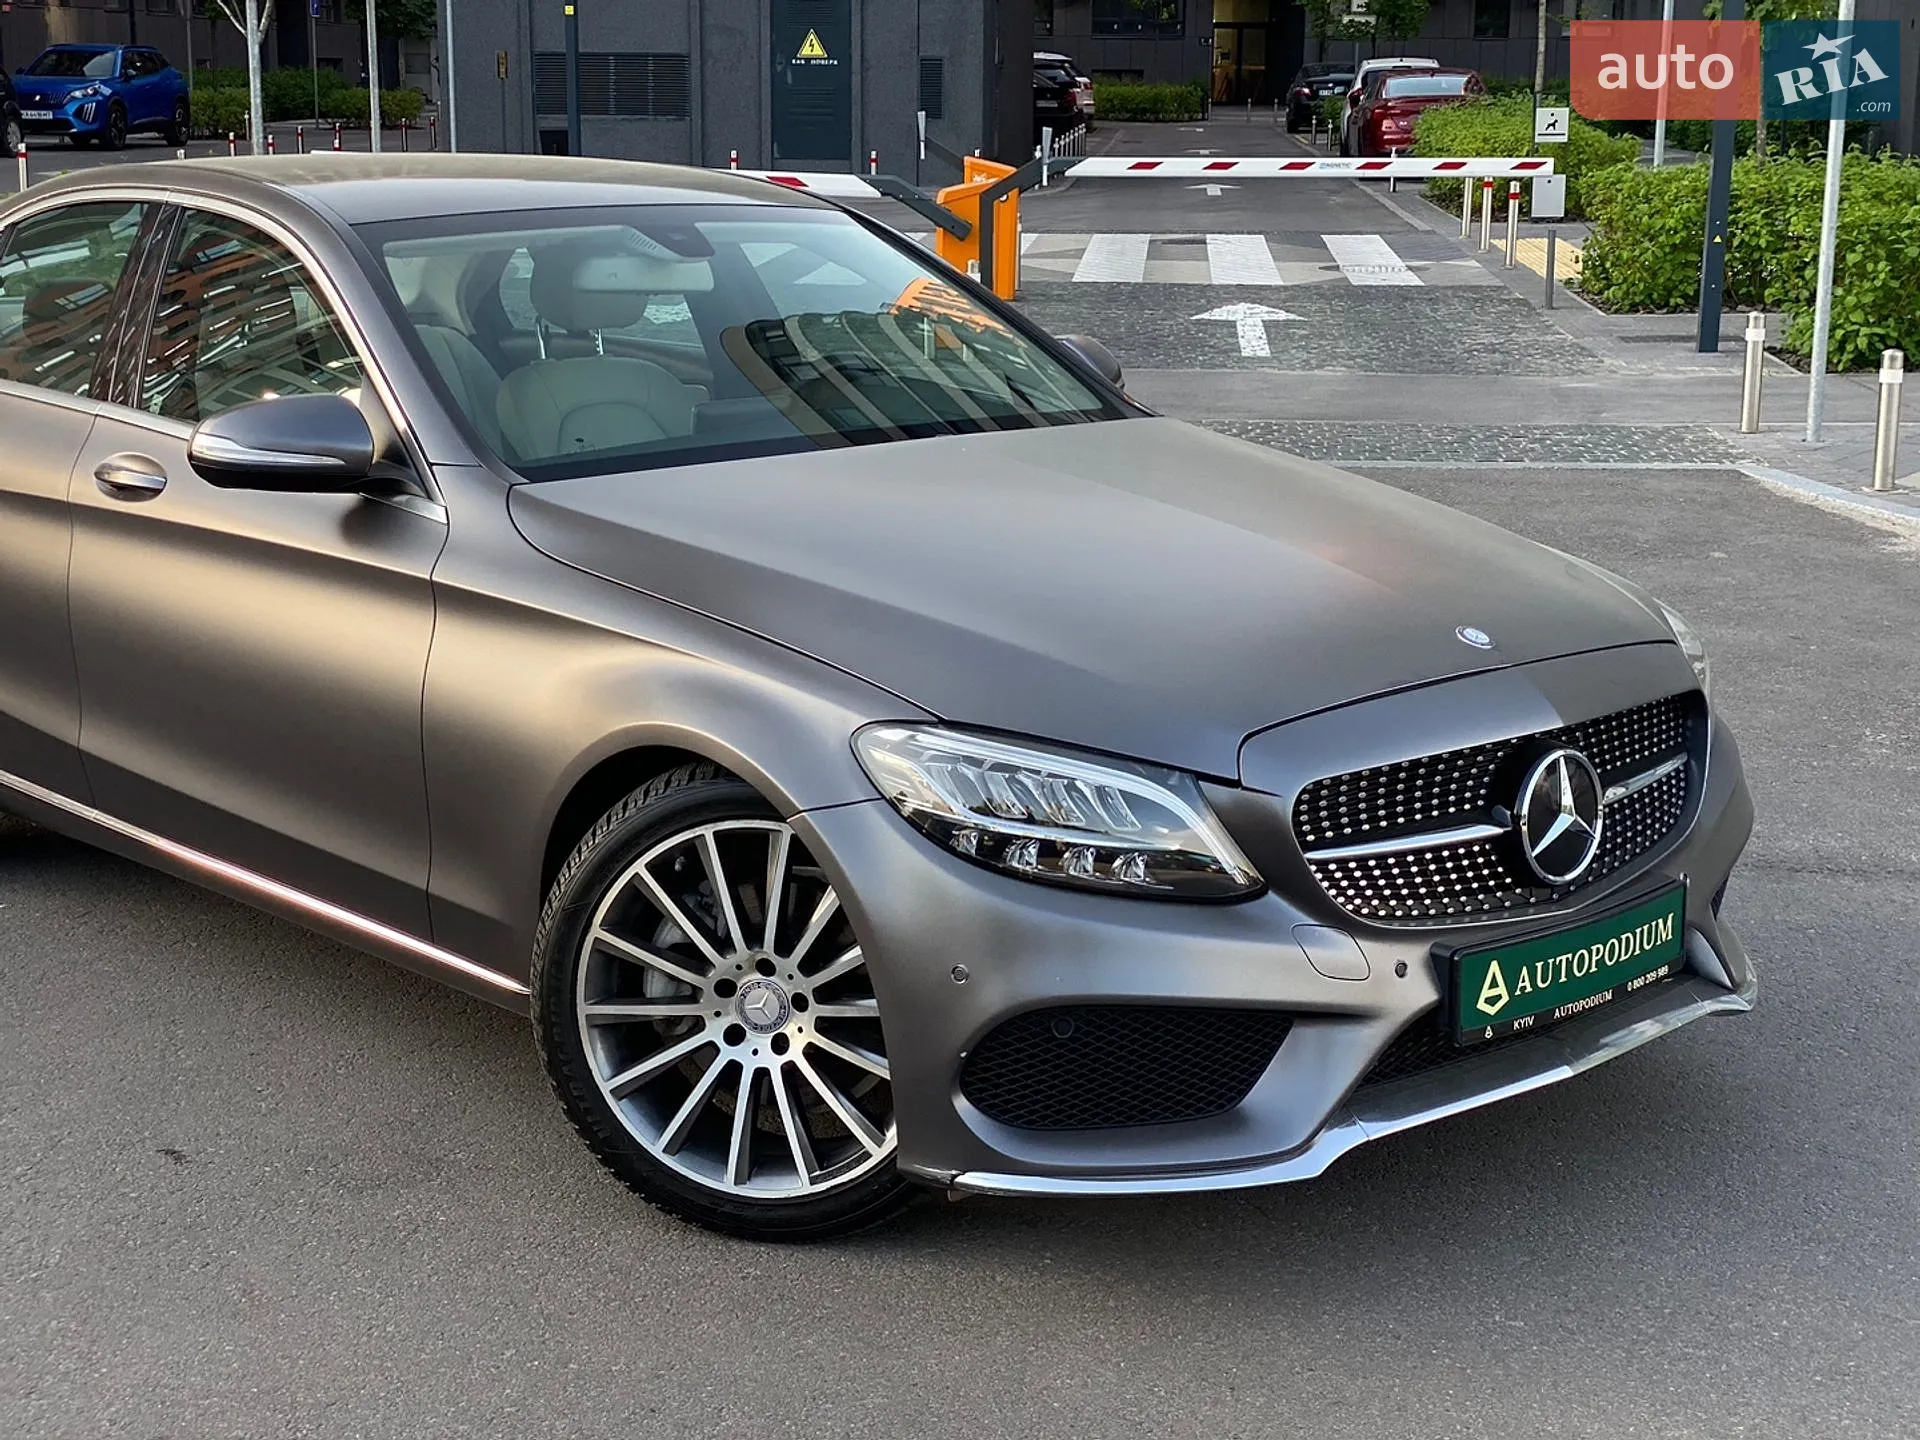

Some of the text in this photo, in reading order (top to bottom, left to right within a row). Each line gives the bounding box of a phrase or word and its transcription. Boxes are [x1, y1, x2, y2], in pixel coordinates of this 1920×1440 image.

[1514, 912, 1674, 996] AUTOPODIUM
[1513, 1015, 1535, 1031] KYIV
[1553, 989, 1613, 1019] AUTOPODIUM
